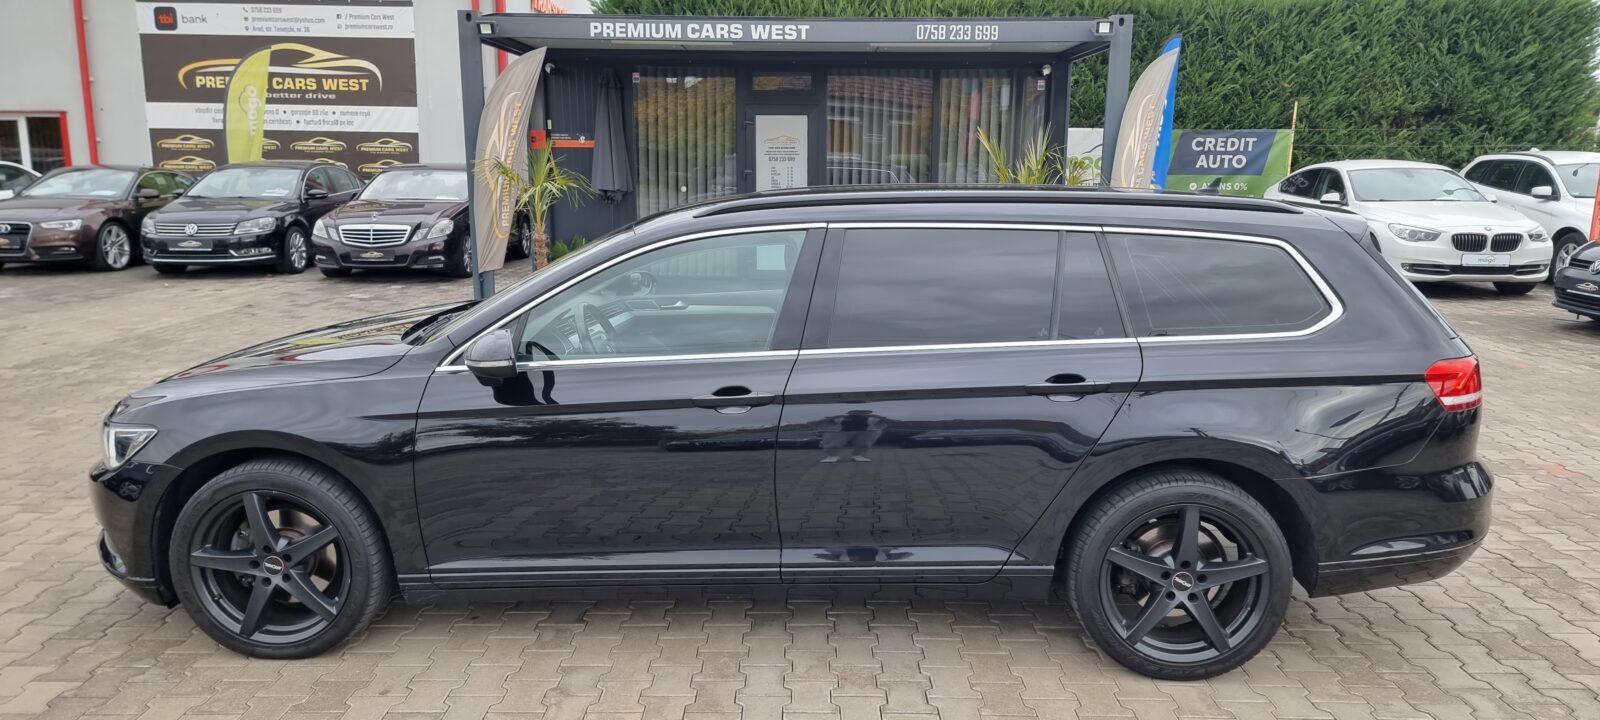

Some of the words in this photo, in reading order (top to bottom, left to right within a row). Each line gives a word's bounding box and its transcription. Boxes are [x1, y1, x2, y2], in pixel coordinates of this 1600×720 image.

[181, 14, 208, 24] bank
[589, 22, 682, 39] PREMIUM
[686, 23, 743, 39] CARS
[750, 24, 810, 40] WEST
[916, 24, 946, 40] 0758
[949, 24, 971, 40] 233
[974, 24, 999, 41] 699
[272, 77, 317, 90] CARS
[322, 78, 369, 91] WEST
[1191, 137, 1258, 152] CREDIT
[1195, 154, 1247, 169] AUTO
[1201, 182, 1232, 190] ANS
[1234, 182, 1248, 191] 0%
